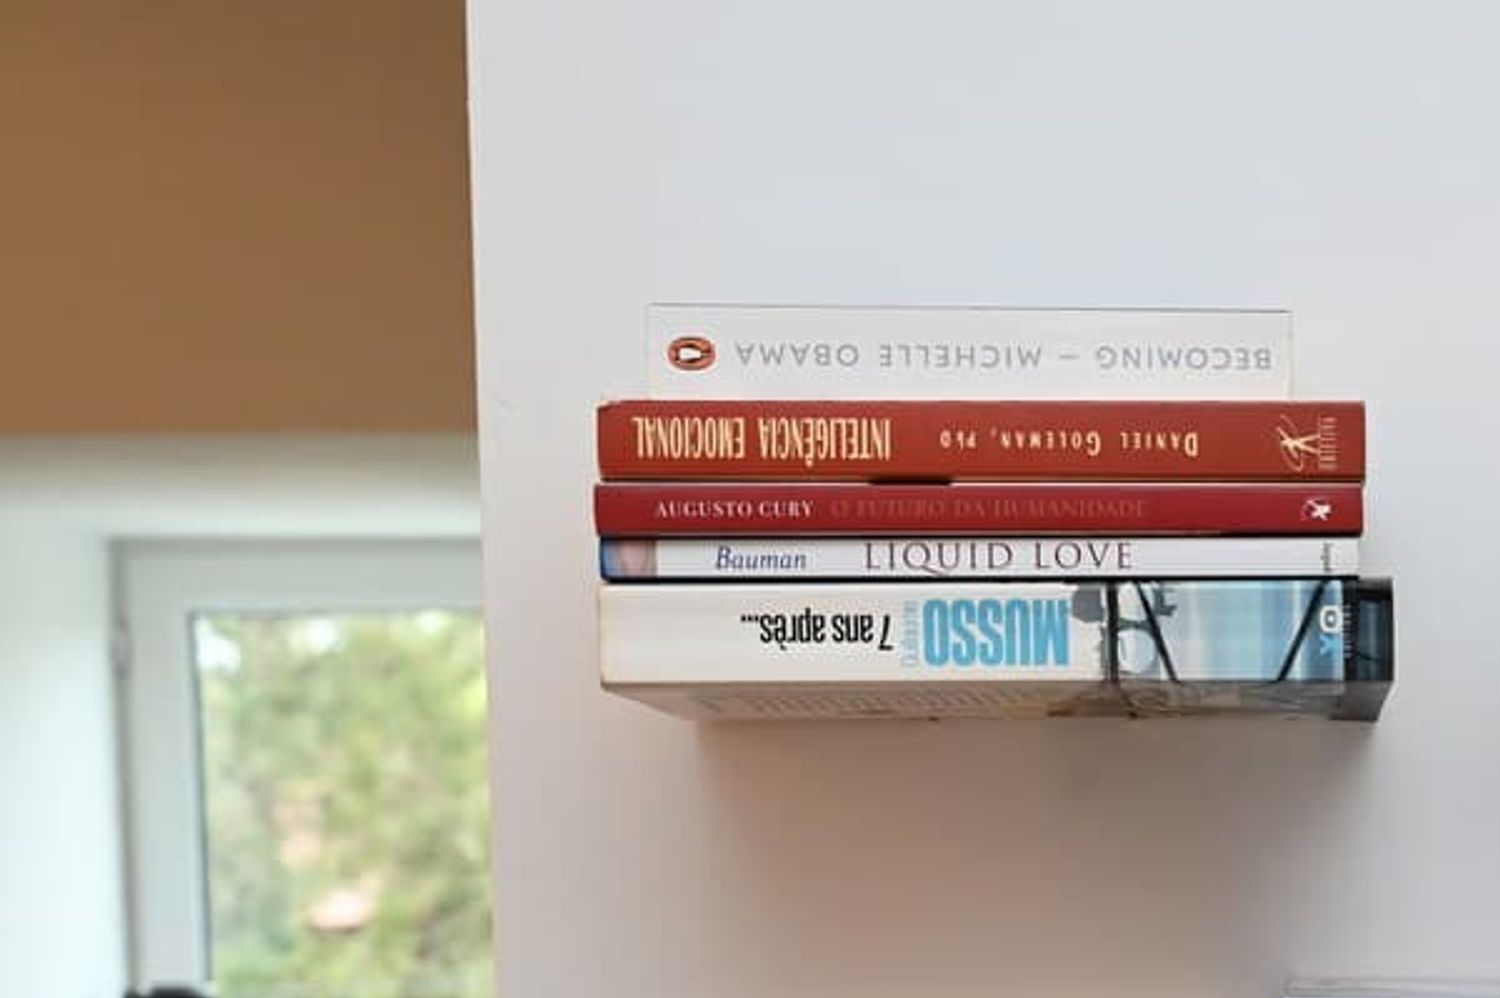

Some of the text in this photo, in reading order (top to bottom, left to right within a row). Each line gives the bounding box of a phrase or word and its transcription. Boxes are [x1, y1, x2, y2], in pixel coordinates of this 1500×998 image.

[735, 343, 860, 367] OBAMA
[880, 345, 1042, 369] MICHELLE
[1096, 345, 1273, 370] BECOMING
[632, 416, 891, 467] INTELIGÊNCIA EMOCIONAL
[655, 500, 816, 519] AUGUSTO CURY
[715, 545, 807, 570] Bauman
[864, 542, 1134, 575] LIQUID LOVE
[831, 614, 875, 644] ans
[878, 613, 894, 651] 7
[922, 599, 1070, 667] MUSSO
